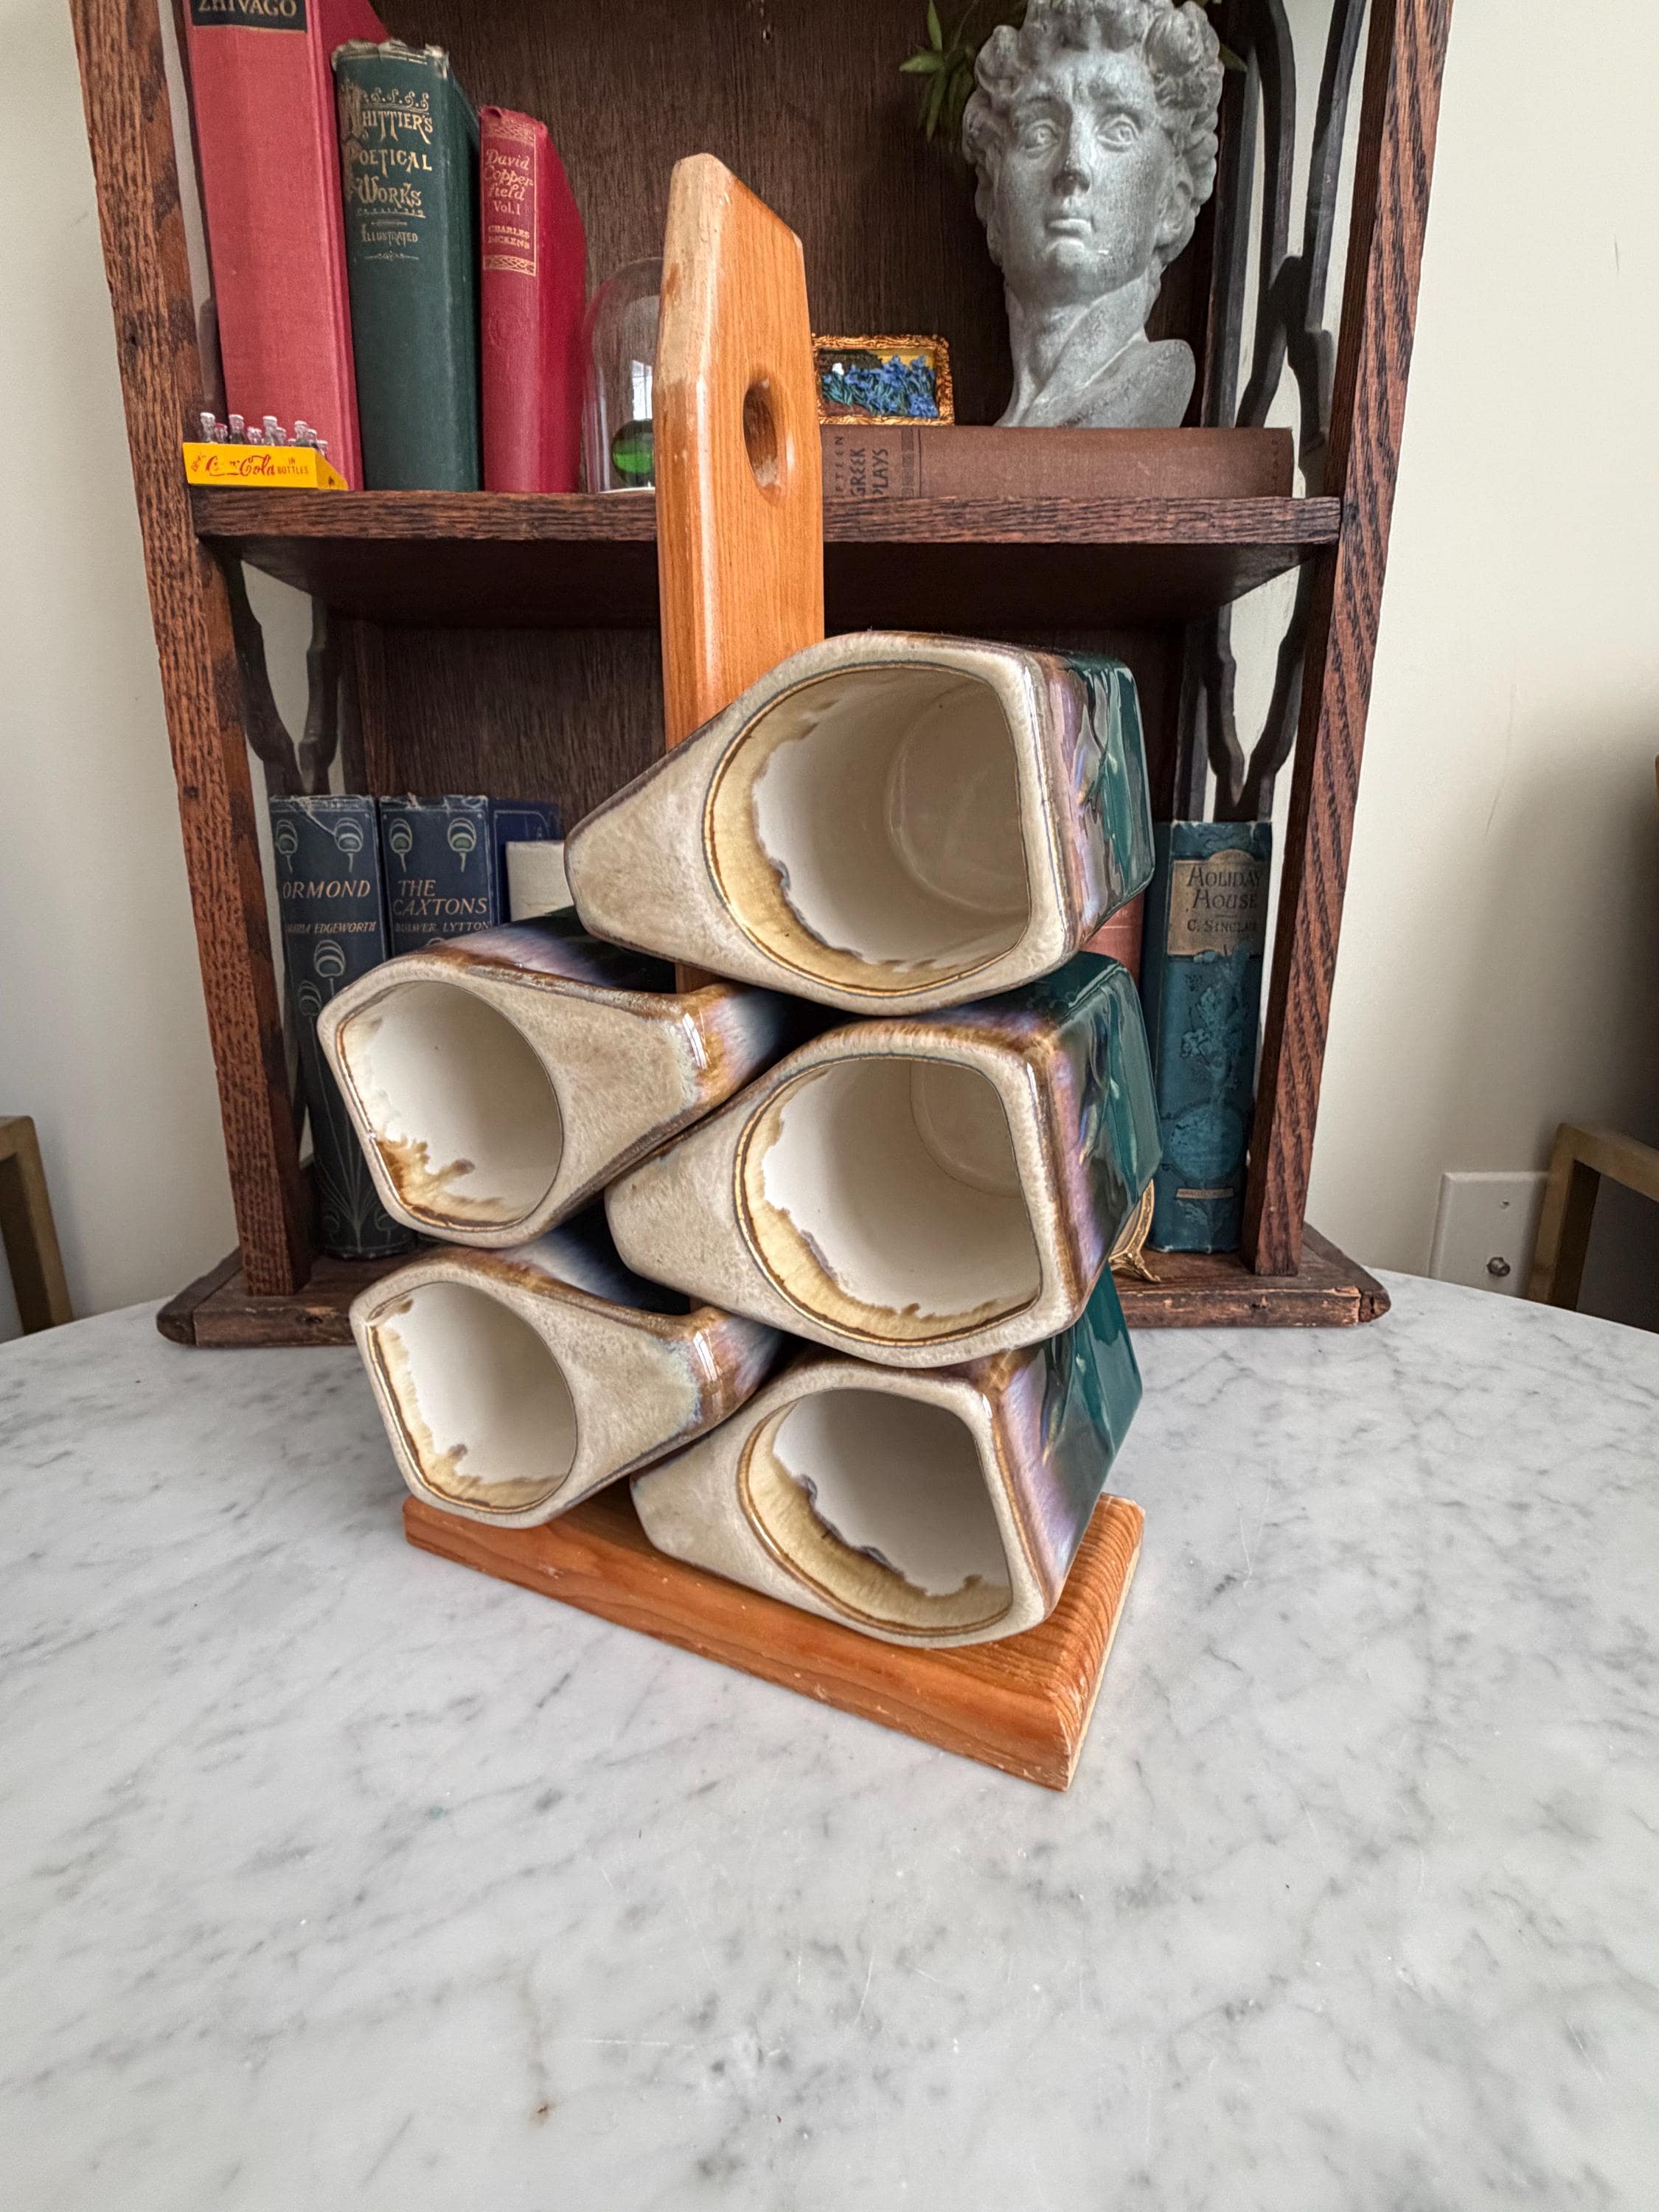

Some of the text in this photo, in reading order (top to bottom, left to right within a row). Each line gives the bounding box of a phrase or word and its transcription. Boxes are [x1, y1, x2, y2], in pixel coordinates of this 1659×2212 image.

[485, 148, 530, 170] David
[353, 173, 422, 209] WORKS
[488, 181, 526, 201] field
[493, 200, 515, 214] Vol.
[361, 223, 418, 247] ILLUSTRATED
[488, 225, 530, 239] CHARLES
[488, 236, 530, 249] DICKENS
[277, 465, 309, 474] BOTTLES
[834, 436, 845, 493] FTEEN
[849, 448, 866, 497] GREEK
[1186, 866, 1263, 887] HOLIDAY
[282, 880, 371, 899] ORMOND
[398, 879, 437, 897] THE
[392, 897, 487, 916] CAXTONS
[1192, 888, 1258, 909] HOUSE
